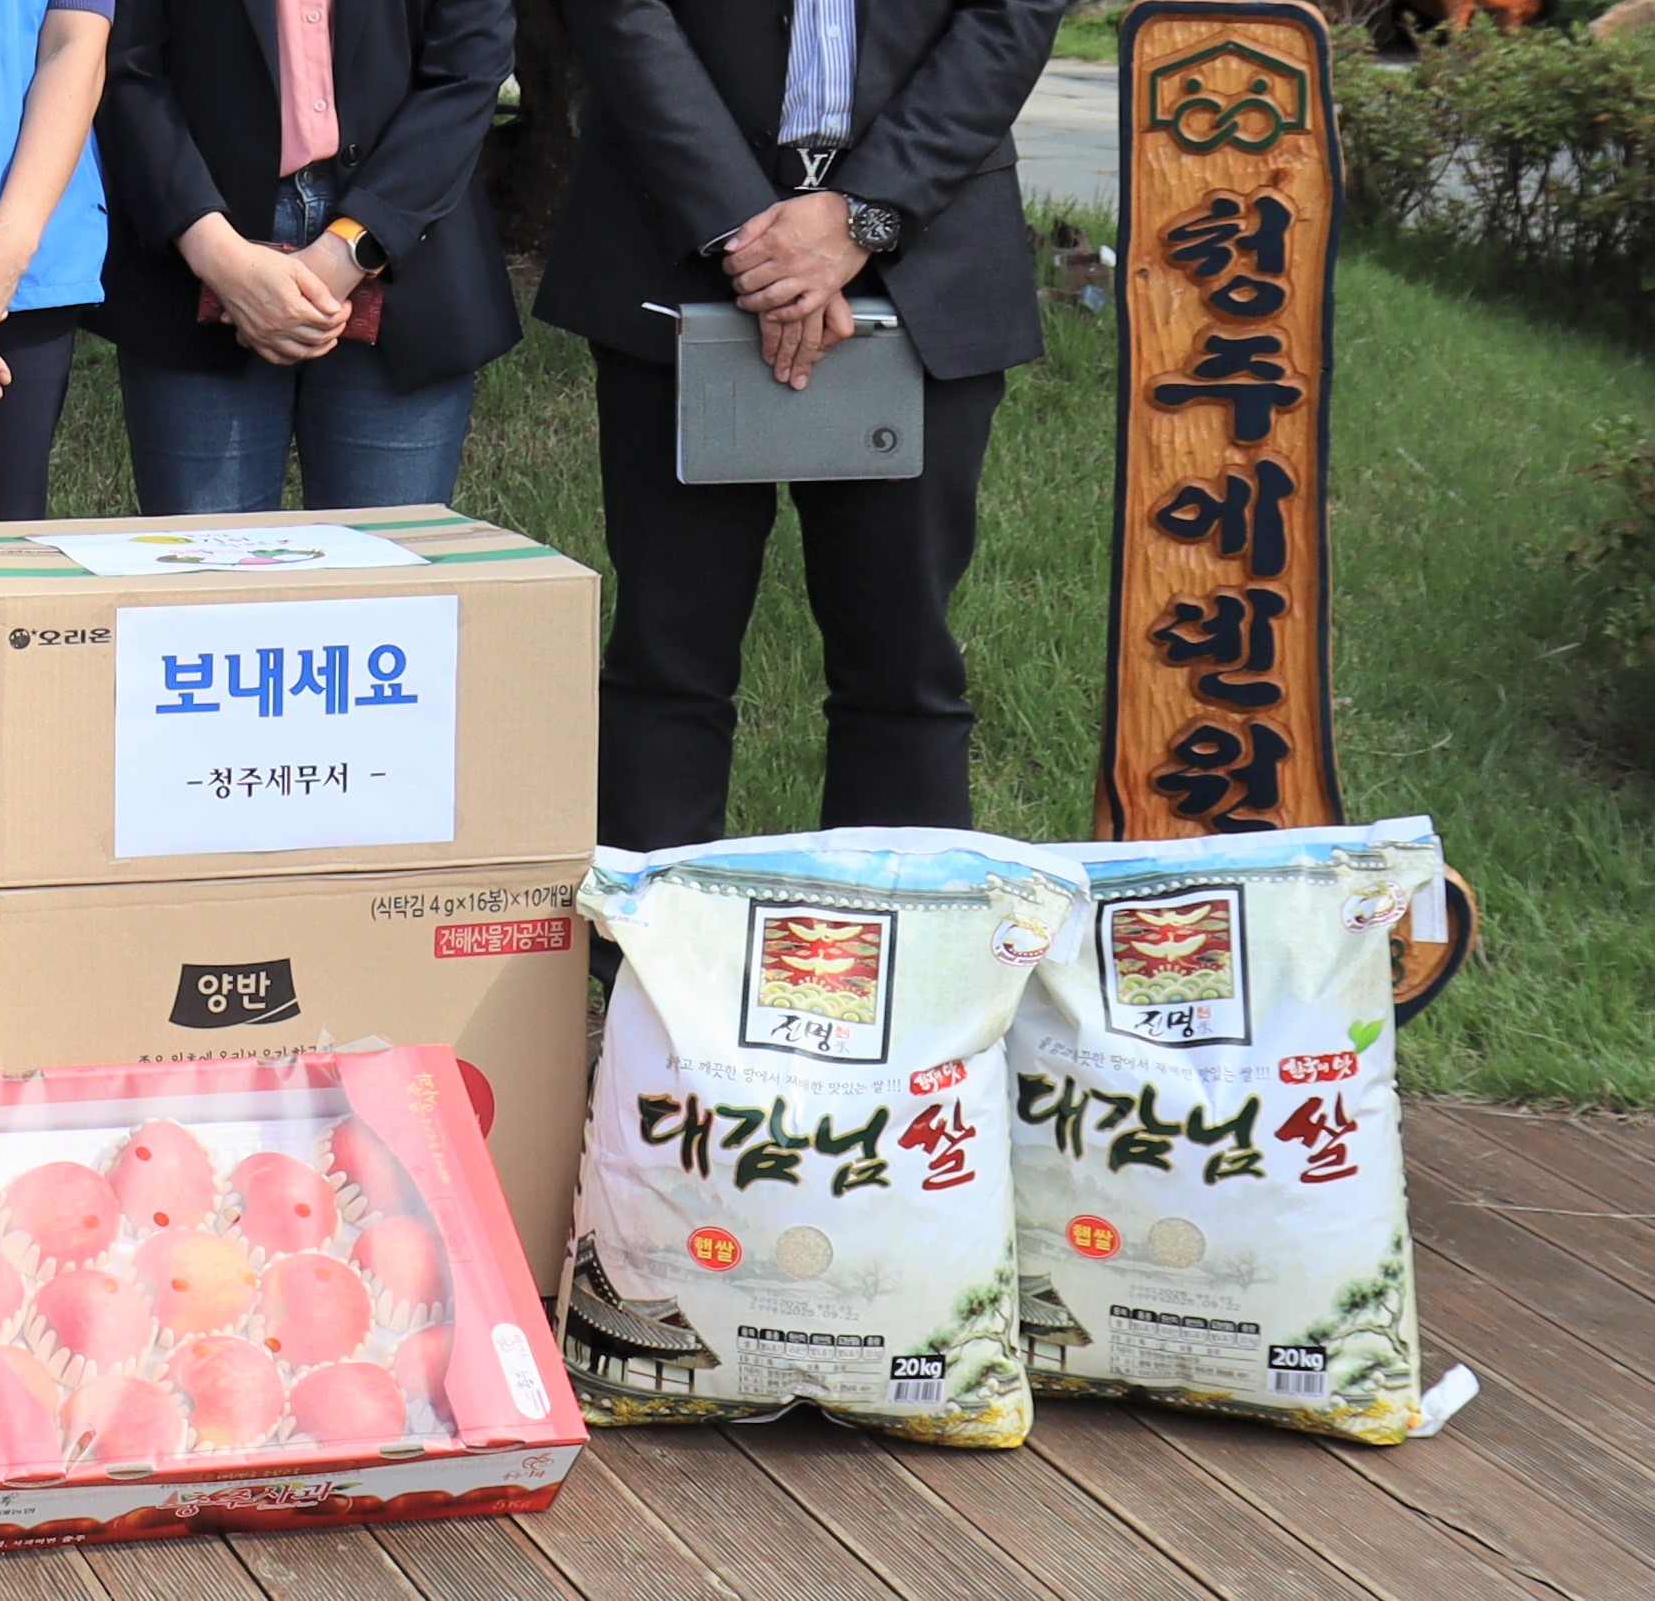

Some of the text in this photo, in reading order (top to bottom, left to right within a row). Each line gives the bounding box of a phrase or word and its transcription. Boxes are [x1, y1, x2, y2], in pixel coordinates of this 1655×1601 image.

[38, 628, 112, 647] 오리온
[155, 644, 419, 718] 보내세요
[371, 894, 425, 921] (식탁김
[429, 895, 440, 914] 4
[439, 920, 566, 955] 건해산물가공식품
[196, 969, 272, 1014] 양반
[1134, 1006, 1197, 1039] 진명
[698, 1061, 738, 1080] 깨끗한
[743, 1067, 781, 1084] 땅에서
[828, 1082, 864, 1096] 맛있는
[1112, 1054, 1149, 1072] 땅에서
[1199, 1067, 1235, 1084] 맛있는
[1282, 1054, 1354, 1082] 한국의 맛
[1017, 1072, 1360, 1186] 대감님 쌀
[638, 1093, 977, 1199] 대감님 쌀
[693, 1235, 737, 1262] 햅쌀
[1073, 1224, 1115, 1251] 햅쌀
[894, 1357, 943, 1379] 20kg
[1271, 1347, 1324, 1371] 20kg
